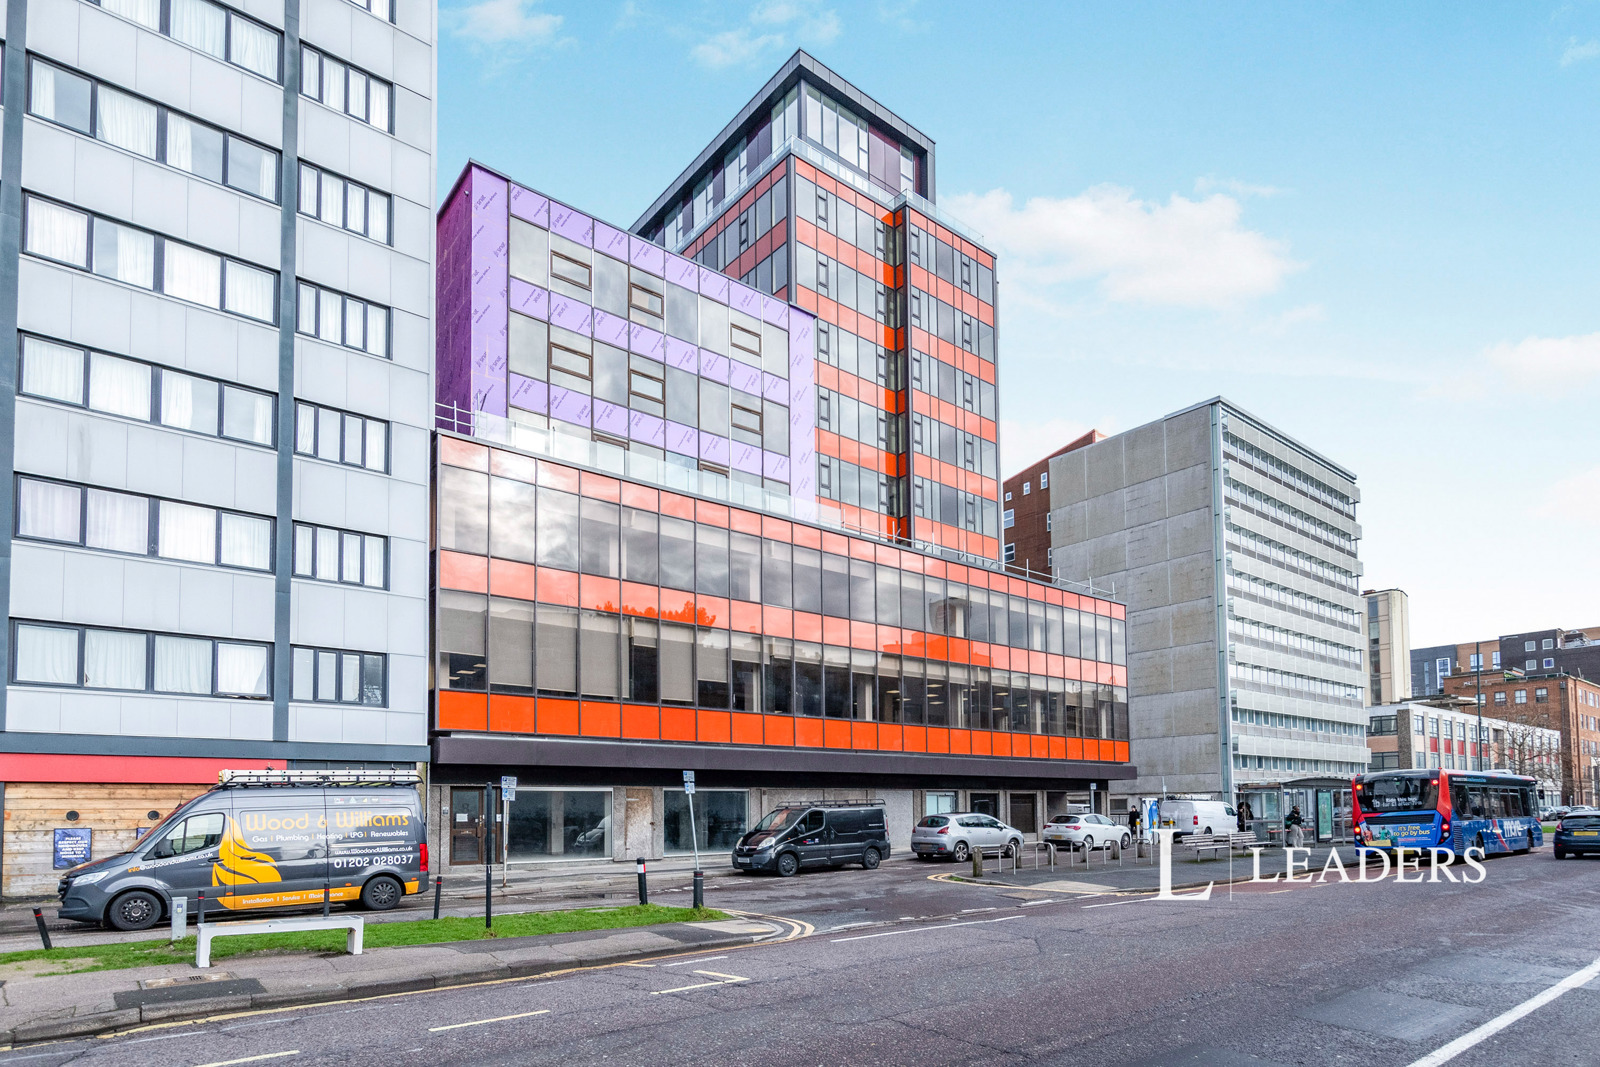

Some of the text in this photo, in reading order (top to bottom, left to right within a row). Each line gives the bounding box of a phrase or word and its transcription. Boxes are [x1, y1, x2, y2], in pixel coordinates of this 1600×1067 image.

[245, 812, 309, 832] Wood
[335, 810, 409, 828] Williams
[252, 830, 409, 843] Gas Plumbing Heating LPG Renewables
[333, 854, 414, 868] 01202 028037
[242, 897, 274, 905] Installation
